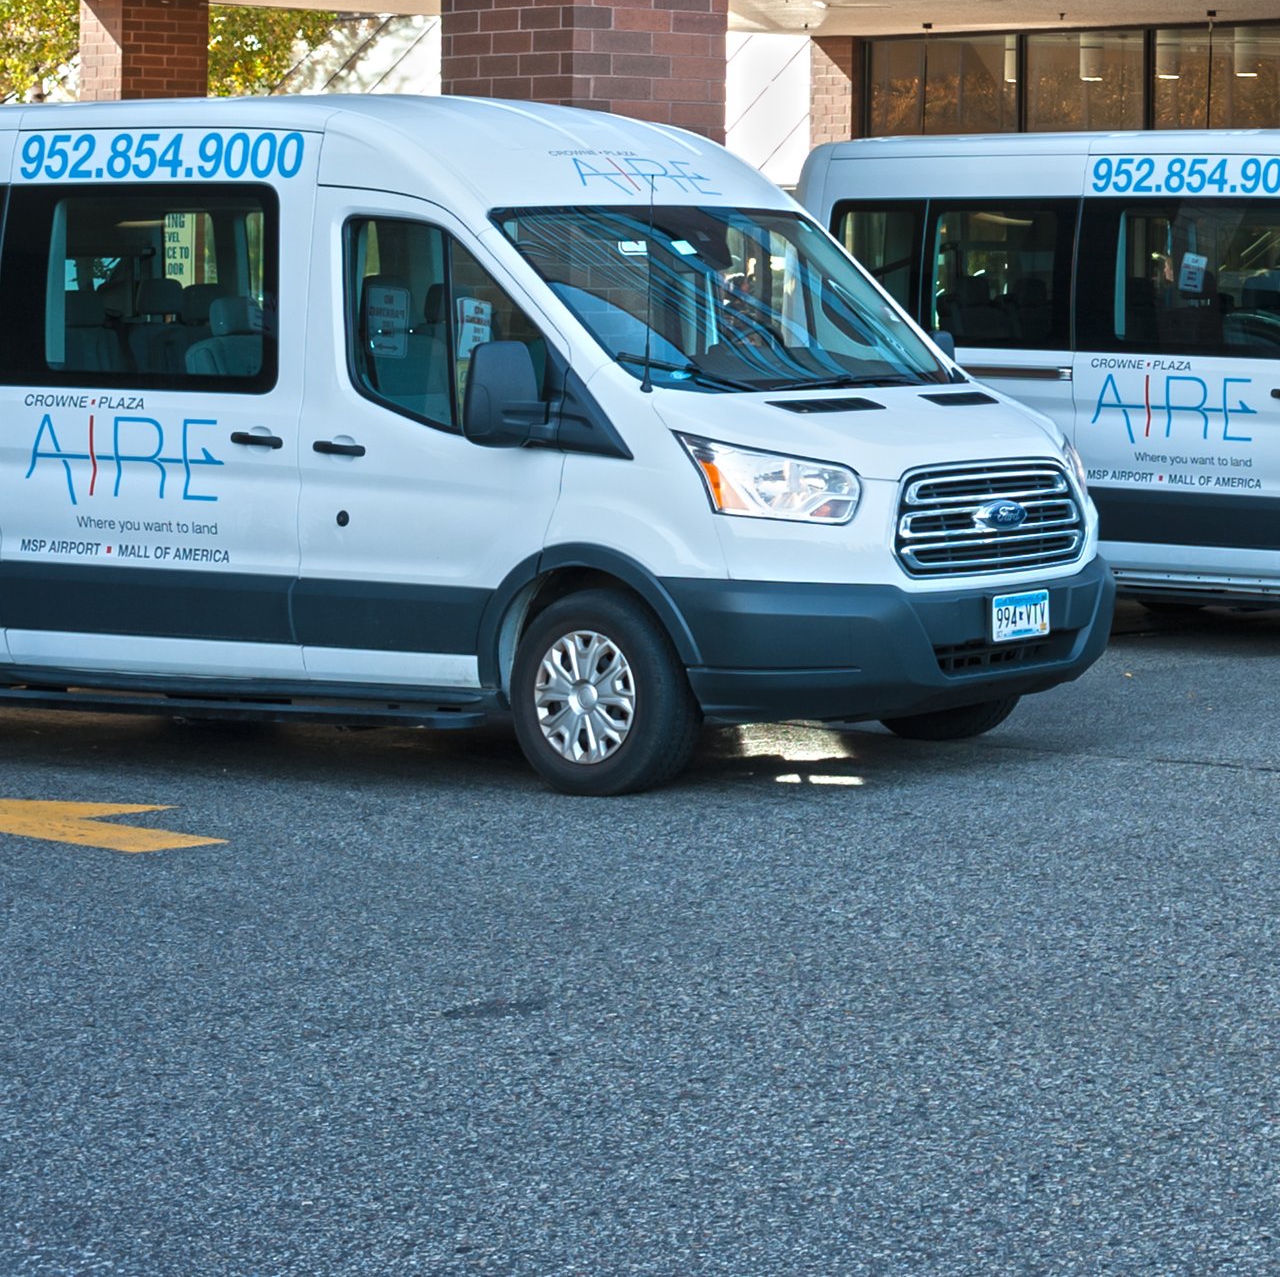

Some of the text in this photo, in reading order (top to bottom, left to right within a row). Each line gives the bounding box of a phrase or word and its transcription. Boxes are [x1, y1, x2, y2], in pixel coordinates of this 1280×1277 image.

[20, 131, 305, 179] 952.854.9000
[180, 246, 190, 260] TO
[1090, 358, 1192, 371] CROWNE PLAZA
[24, 393, 145, 410] CROWNE PLAZA
[1091, 373, 1258, 444] AIRE
[25, 413, 225, 506] AIRE
[1134, 452, 1253, 468] Where you want to land
[1086, 469, 1262, 489] MSP AIRPORT MALL OF AMERICA
[76, 515, 219, 535] Where you want to land
[20, 538, 231, 564] MSP AIRPORT MALL OF AMERICA
[996, 601, 1046, 630] 994 VTV
